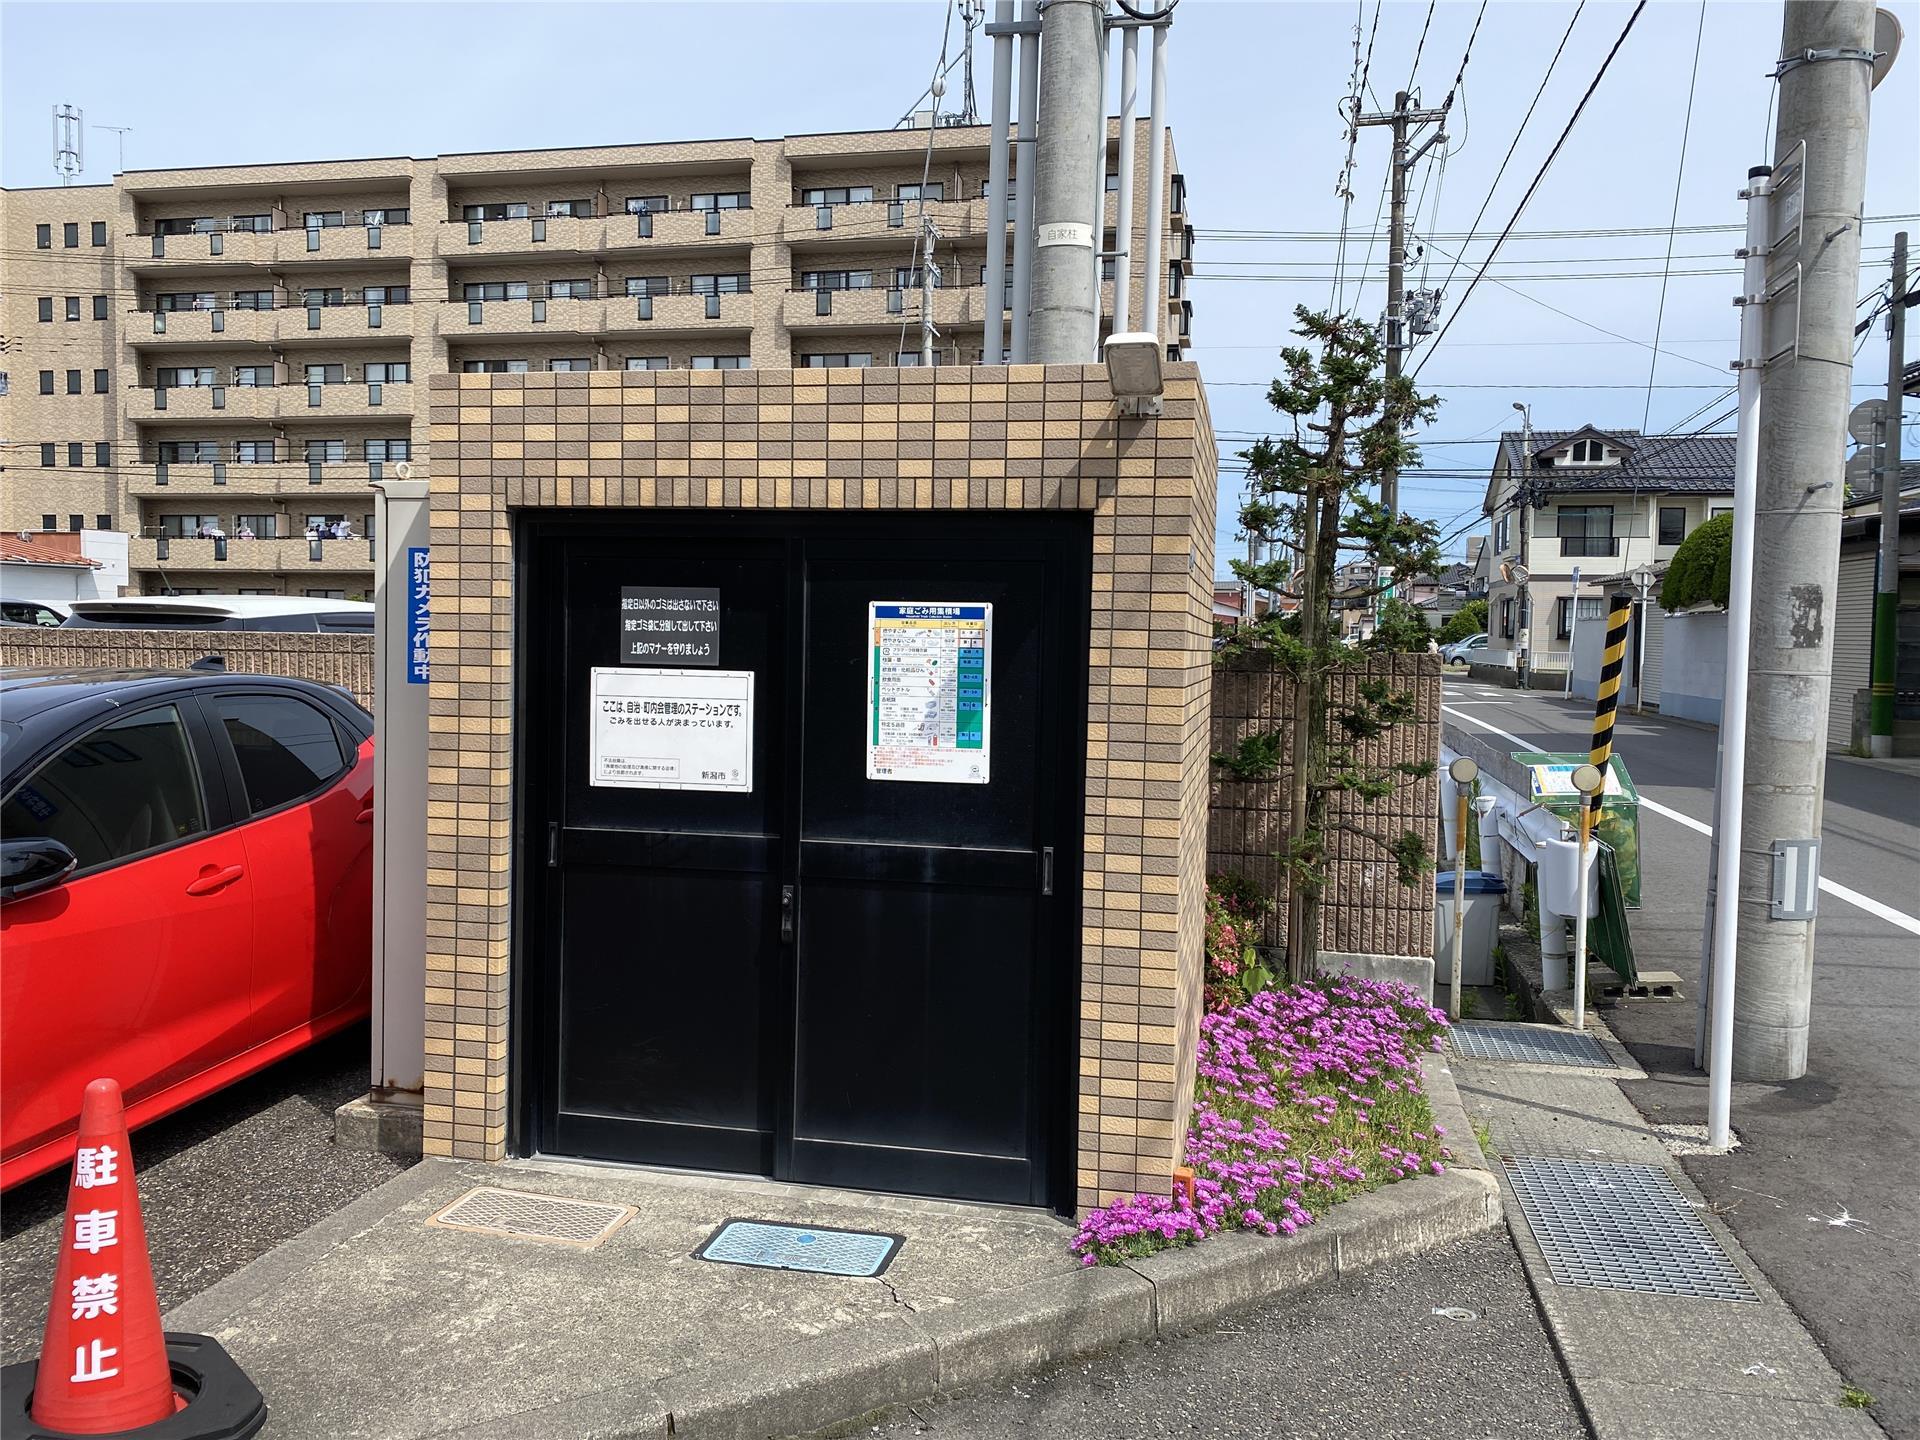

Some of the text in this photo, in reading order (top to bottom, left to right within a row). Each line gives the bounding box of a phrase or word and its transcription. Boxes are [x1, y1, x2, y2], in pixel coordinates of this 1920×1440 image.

[1047, 229, 1079, 241] 自家柱
[621, 598, 719, 611] 指定日以外のゴミは出さないで下さい
[412, 552, 430, 680] 防犯カメラ作動中
[630, 641, 710, 656] 上記のマナーを守りましょう
[609, 716, 734, 729] ごみを出せる人が決まっています。
[701, 770, 726, 780] 新潟市
[70, 1145, 119, 1383] 駐車禁止
